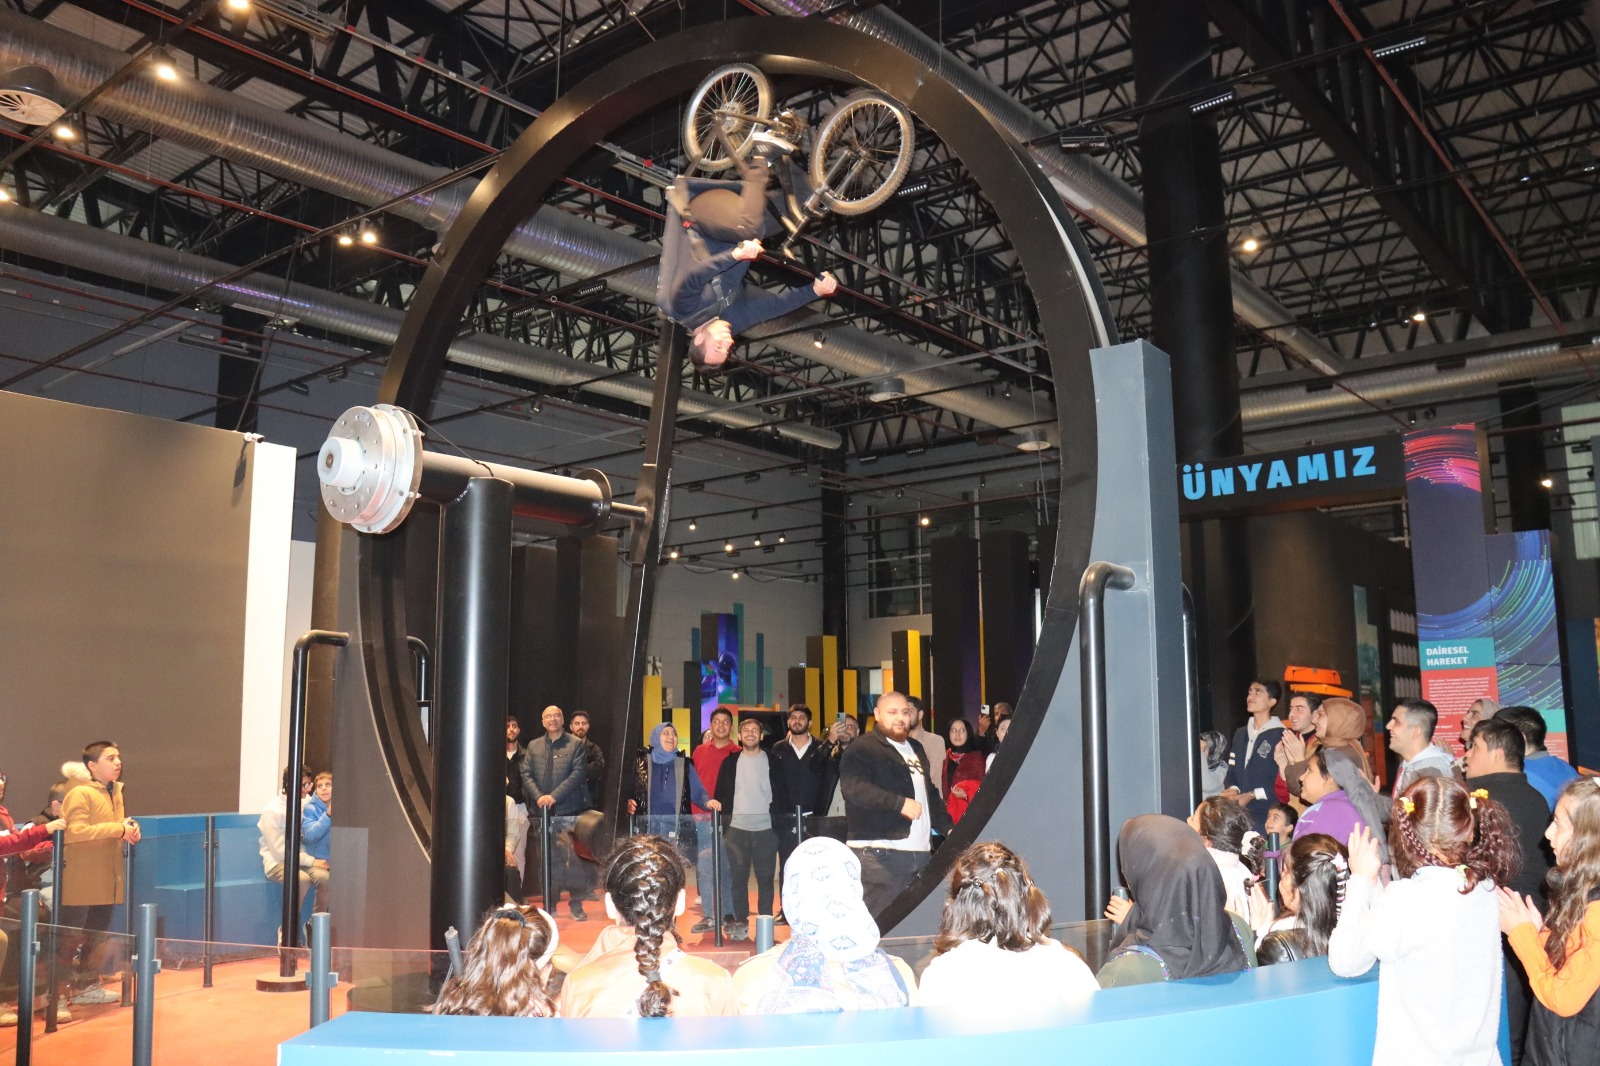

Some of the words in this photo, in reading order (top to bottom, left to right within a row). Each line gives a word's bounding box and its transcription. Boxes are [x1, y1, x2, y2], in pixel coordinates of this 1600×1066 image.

[1183, 446, 1376, 500] ÜNYAMIZ
[1426, 646, 1469, 656] DAİRESEL
[1427, 657, 1468, 666] HAREKET
